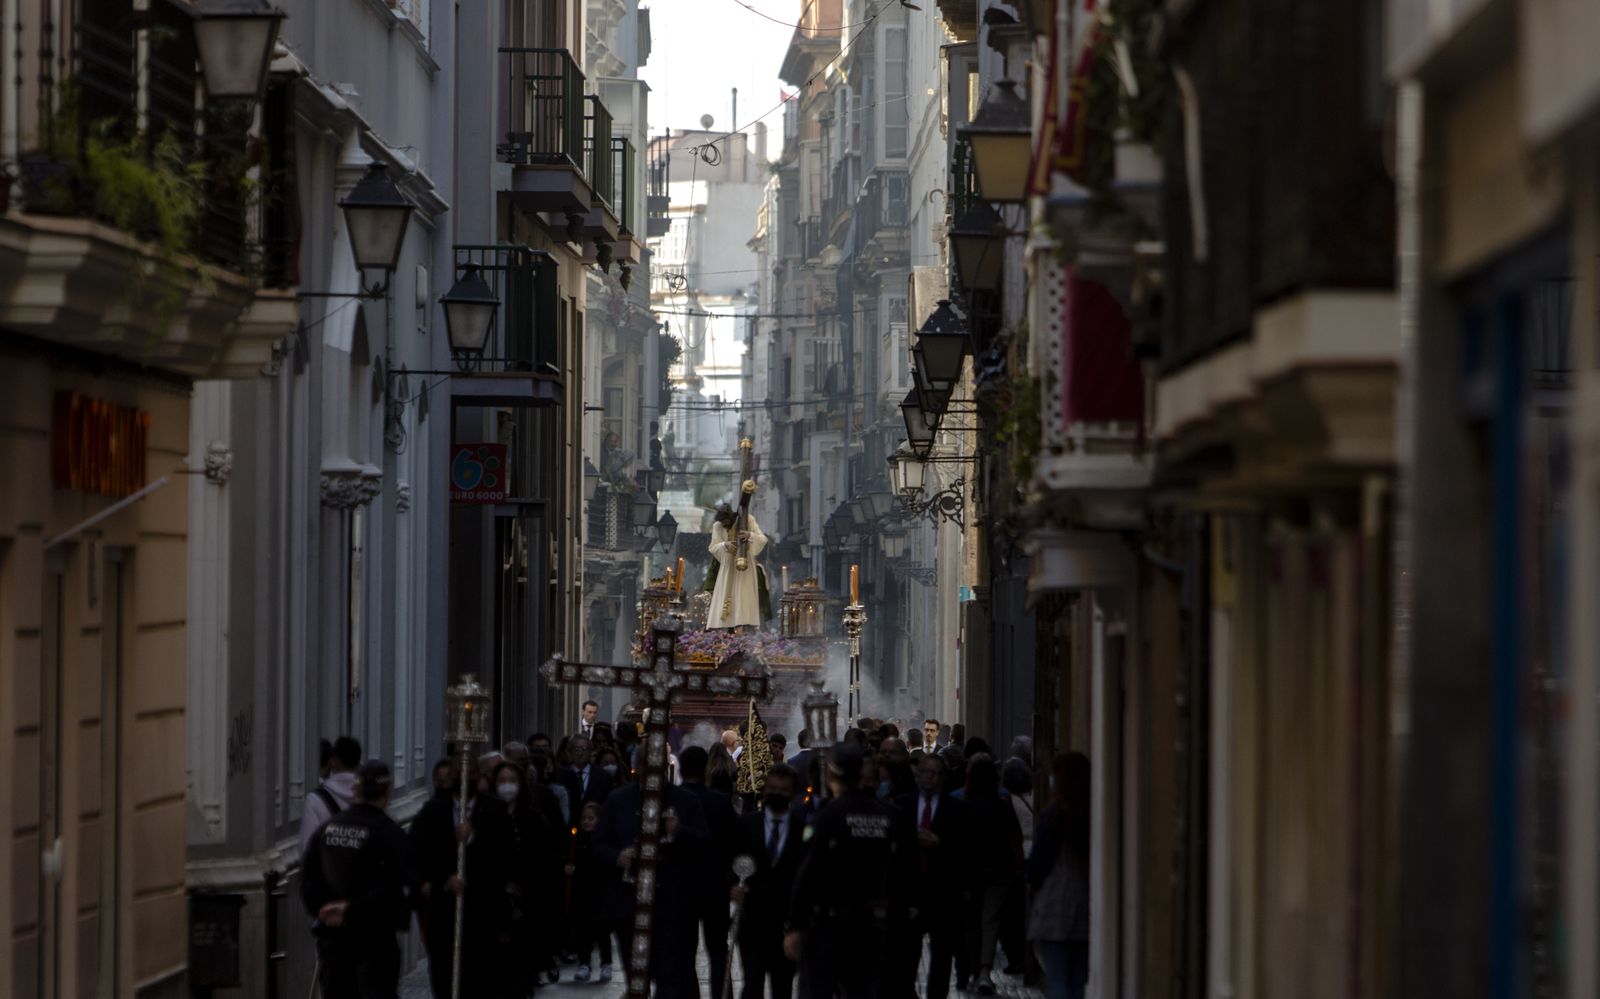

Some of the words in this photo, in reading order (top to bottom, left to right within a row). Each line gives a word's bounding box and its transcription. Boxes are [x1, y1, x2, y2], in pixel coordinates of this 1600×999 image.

[476, 491, 503, 500] 6000
[851, 826, 887, 838] LOCAL
[326, 837, 359, 848] LOCAL
